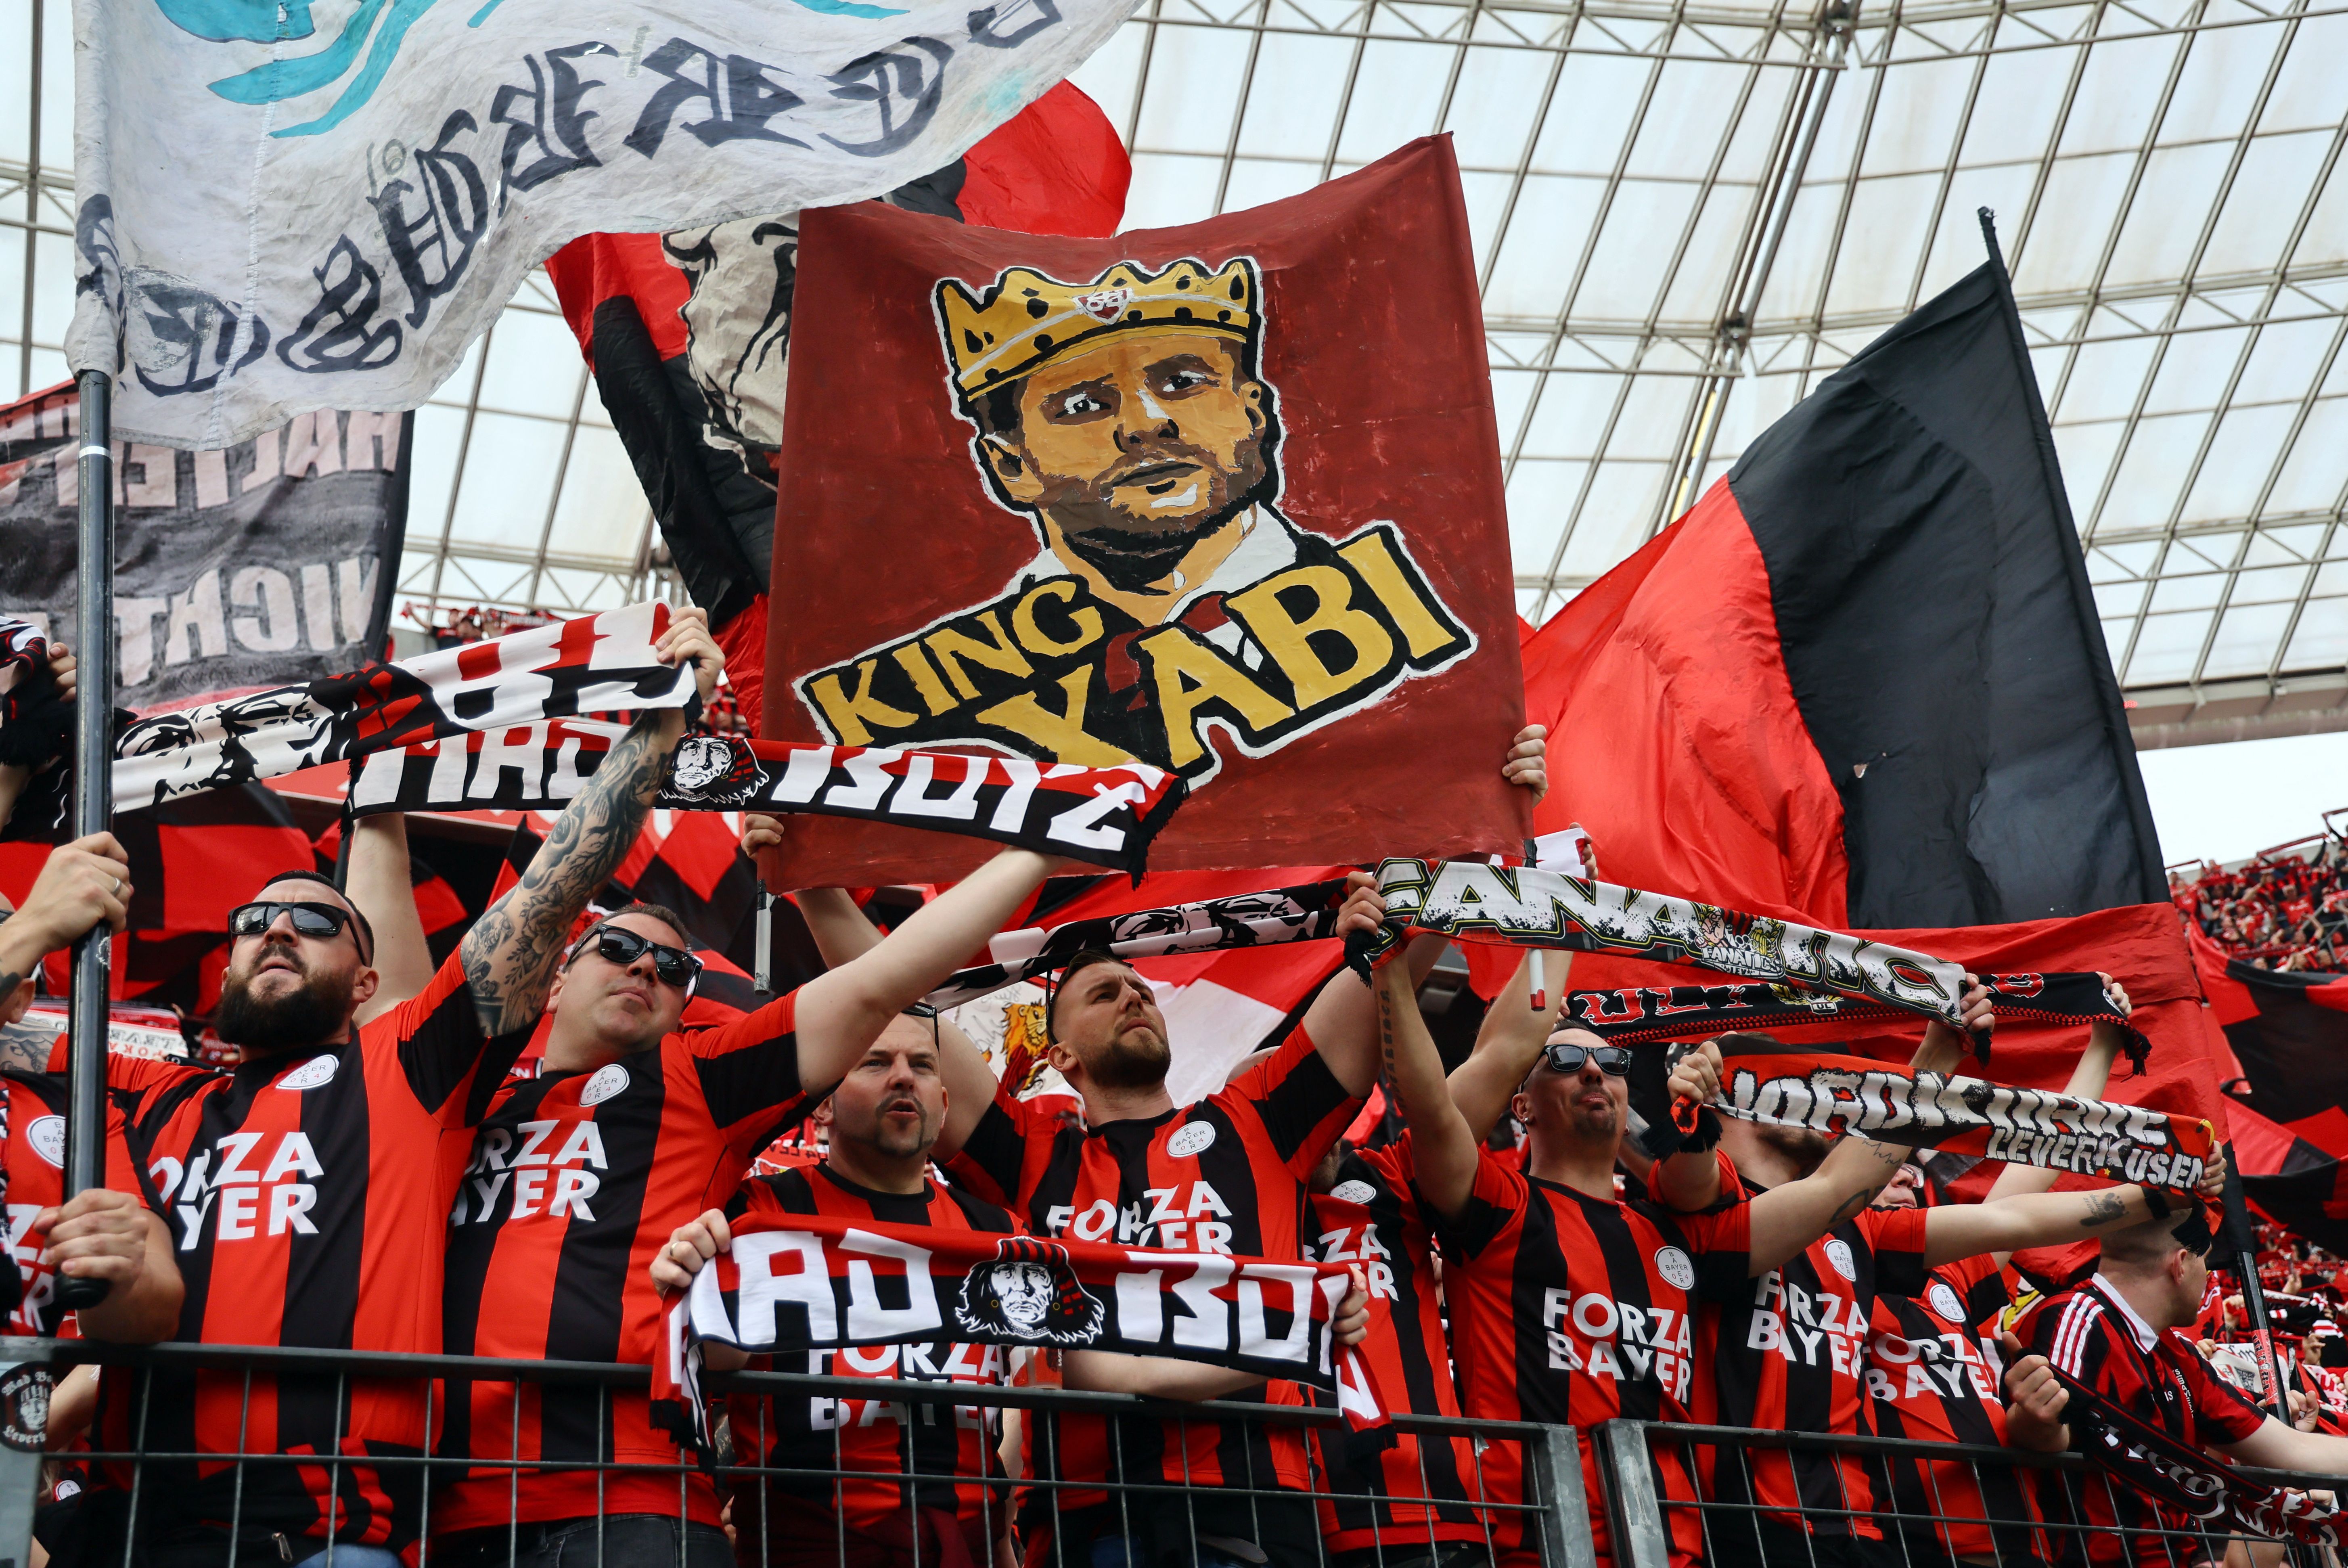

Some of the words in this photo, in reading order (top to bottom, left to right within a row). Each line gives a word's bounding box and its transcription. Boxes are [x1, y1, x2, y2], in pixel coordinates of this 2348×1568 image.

[808, 578, 1105, 748] KING
[977, 534, 1461, 769] YABI
[465, 1119, 609, 1175] RZA
[1986, 1127, 2204, 1189] LEVERKUSEN
[1544, 1287, 1693, 1359] FORZA
[1546, 1331, 1692, 1404] BAYER
[1865, 1363, 2003, 1406] BAYE
